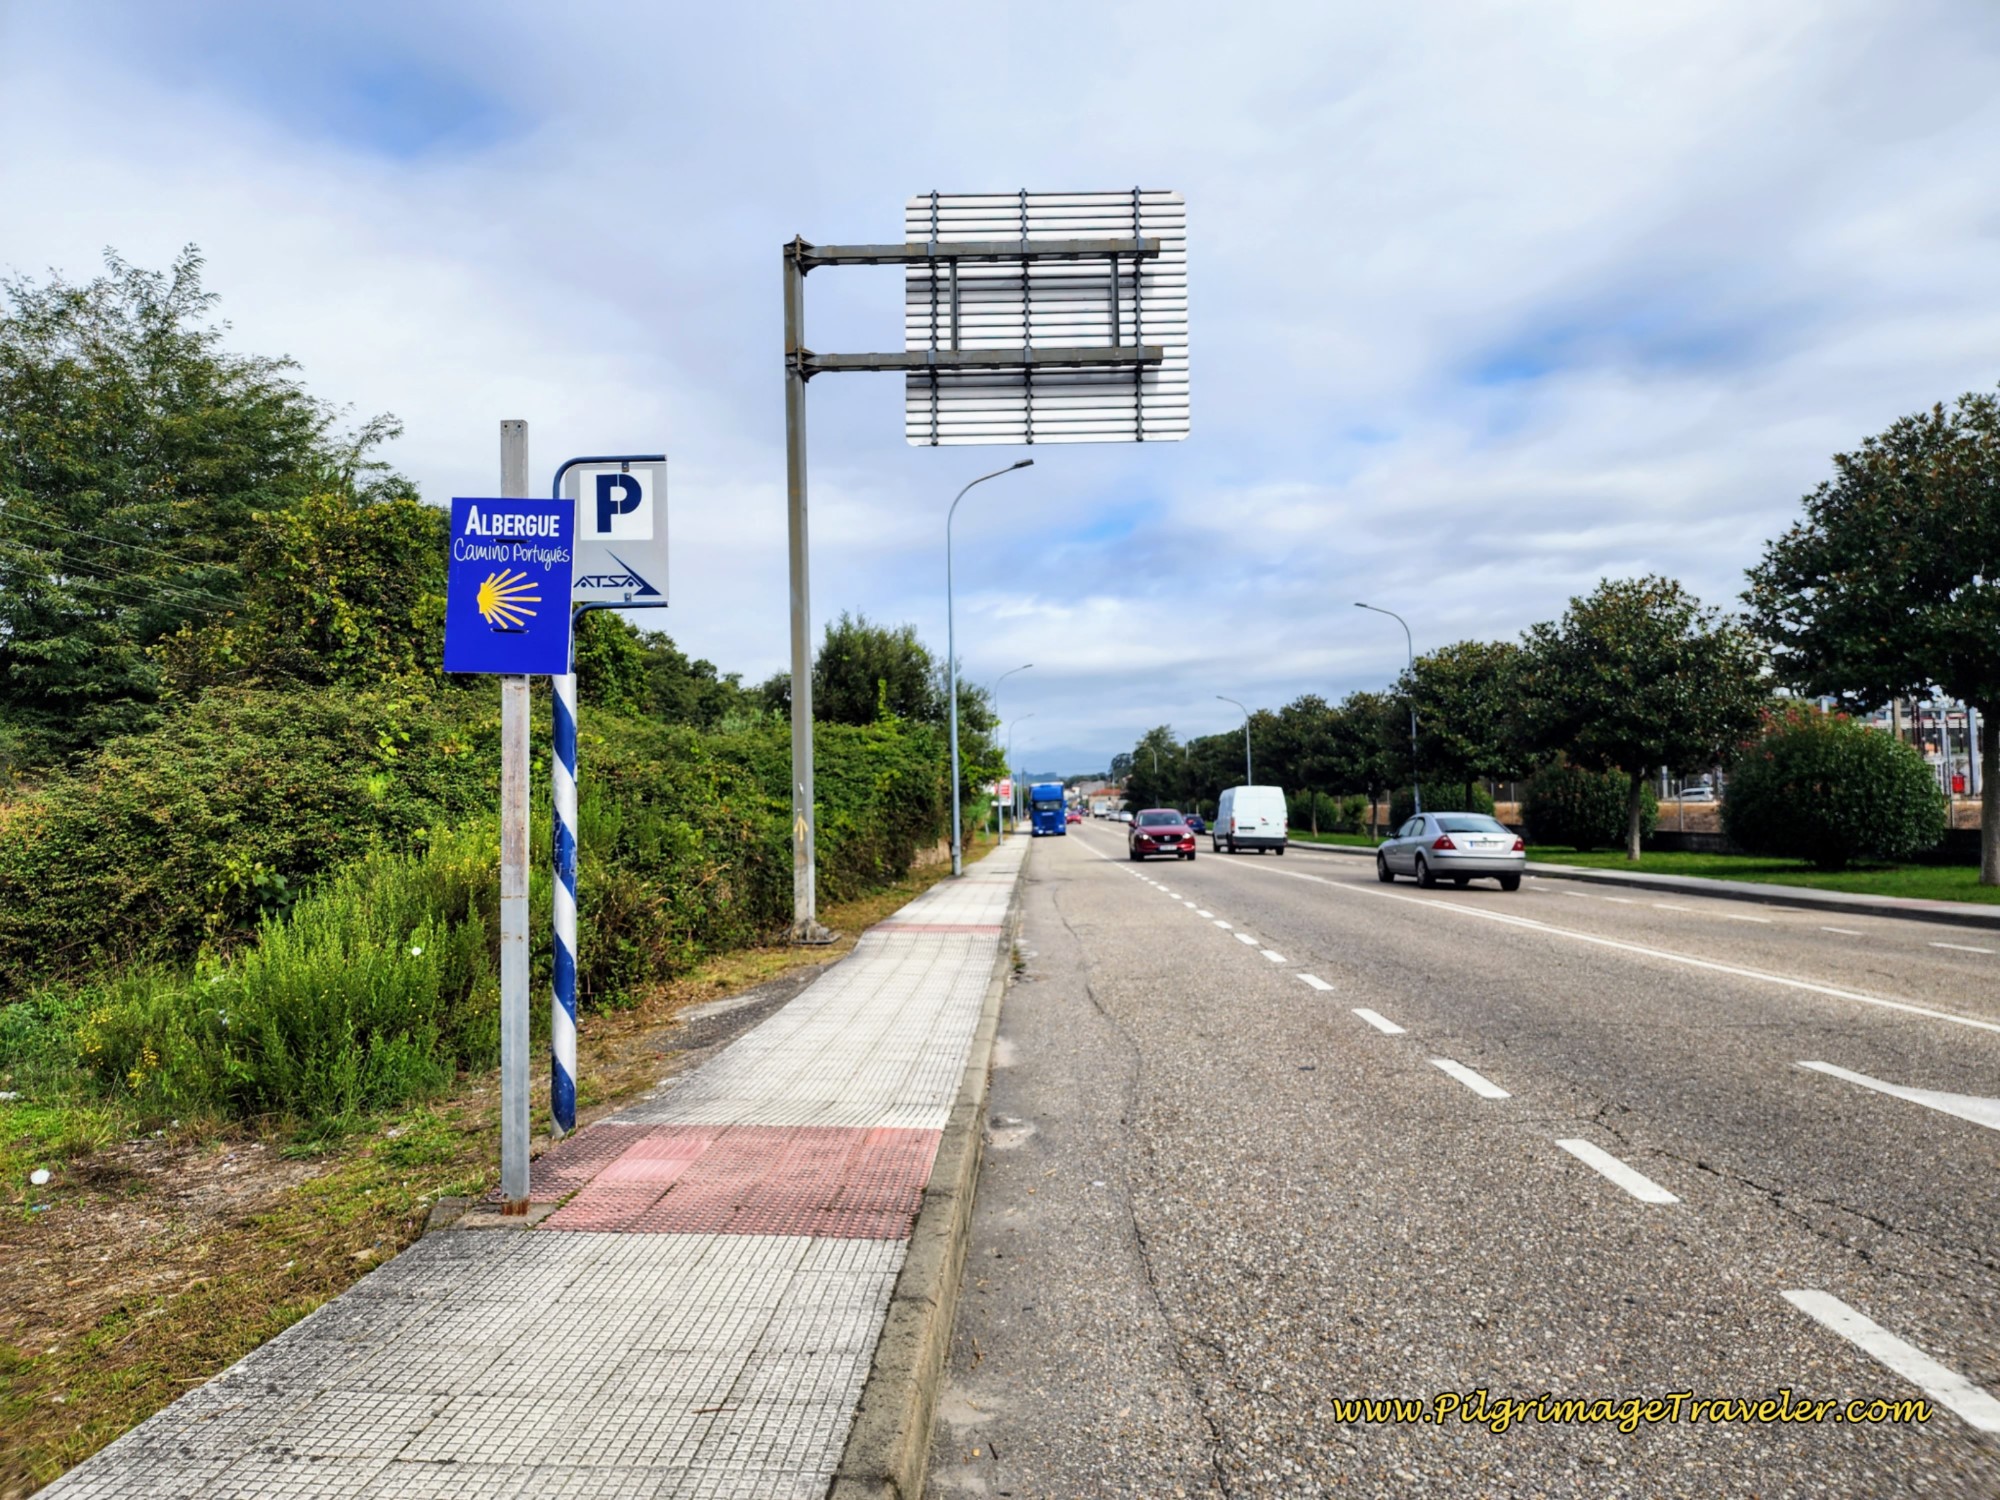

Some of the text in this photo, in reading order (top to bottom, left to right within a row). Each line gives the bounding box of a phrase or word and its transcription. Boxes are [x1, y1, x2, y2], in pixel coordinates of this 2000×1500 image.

[596, 474, 642, 533] P
[464, 505, 560, 537] ALBERGUE
[453, 537, 570, 571] Camino Portugués
[573, 575, 642, 588] ATSA
